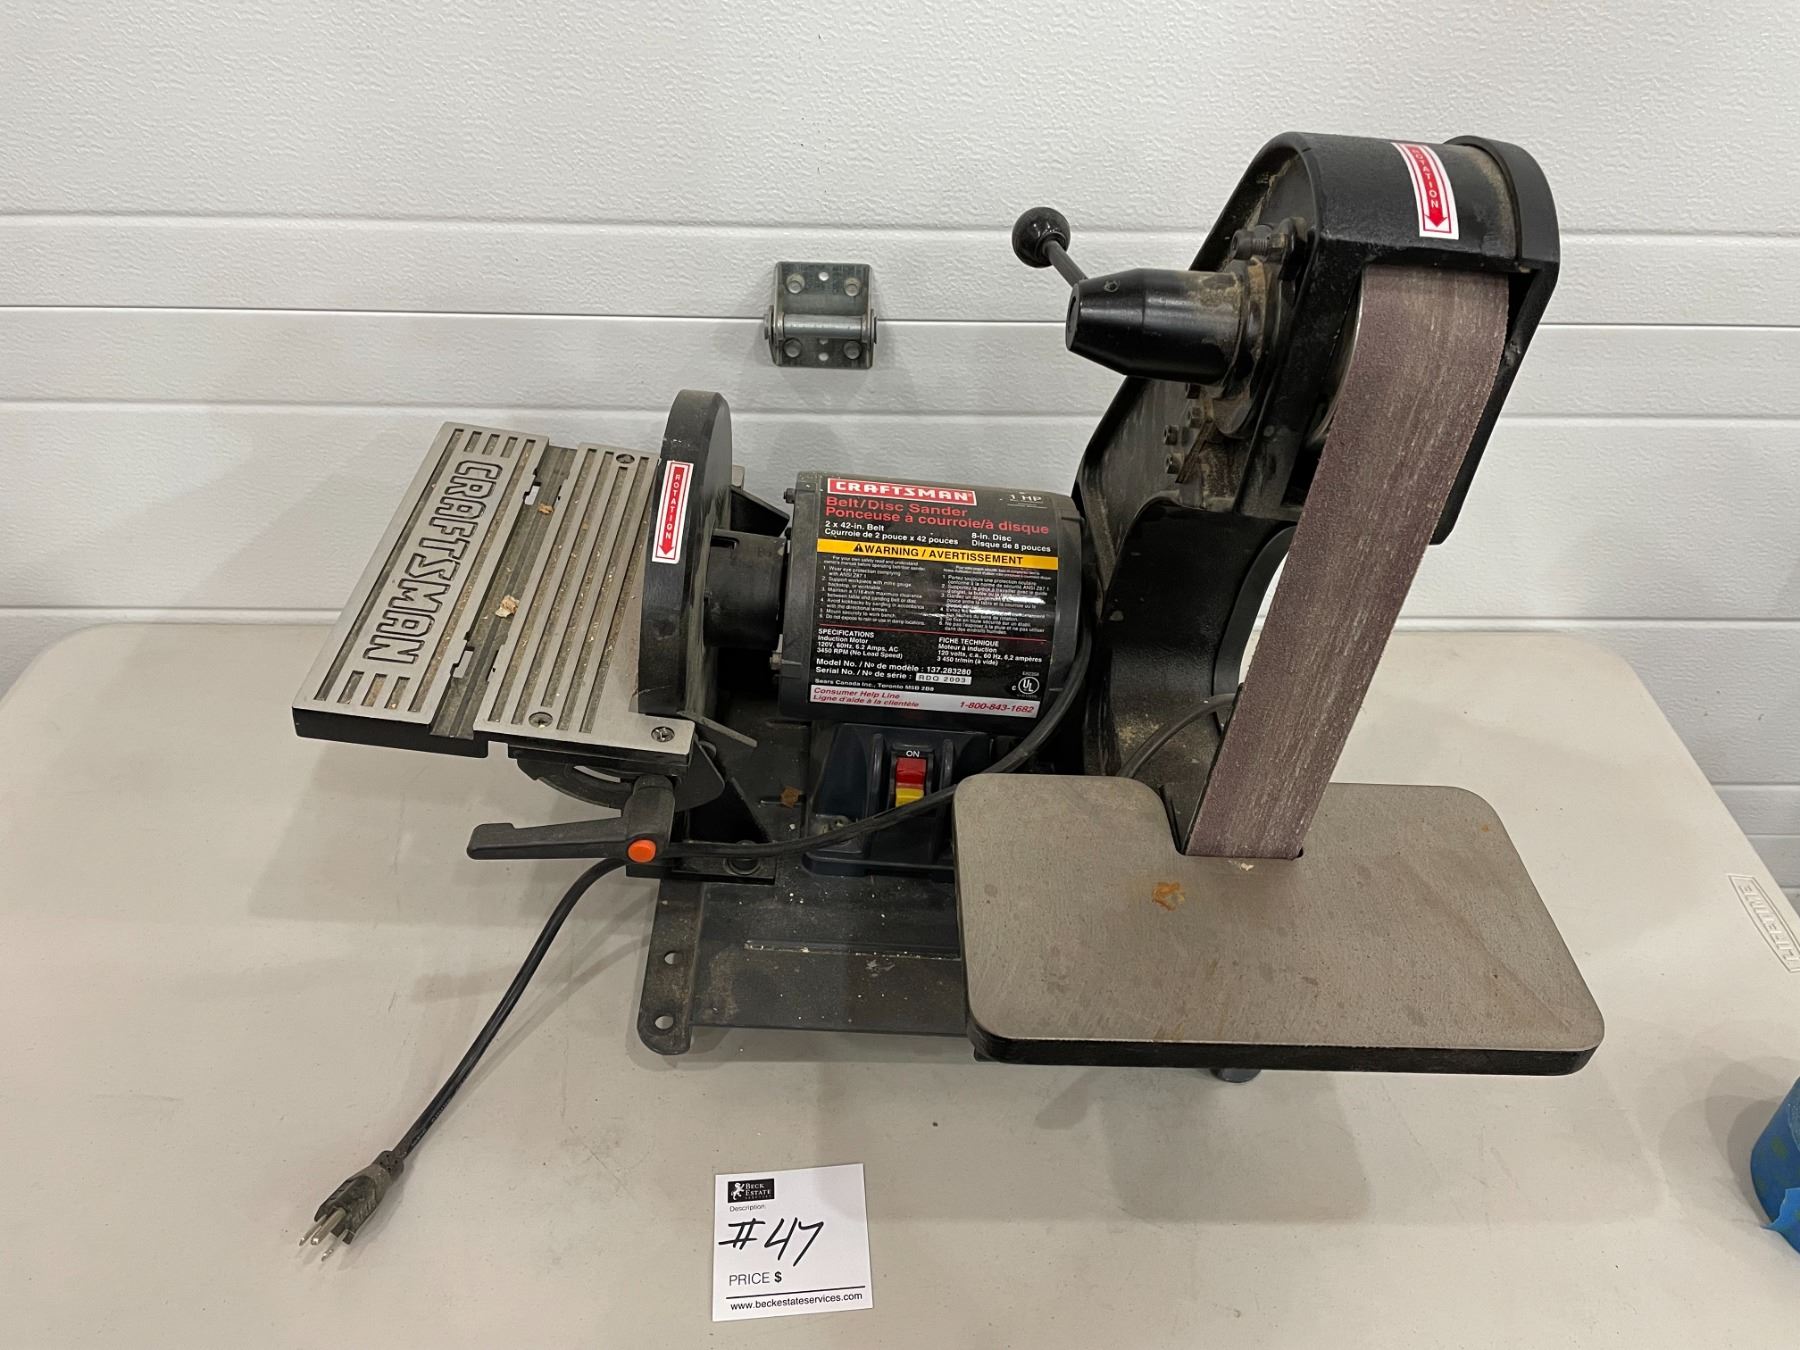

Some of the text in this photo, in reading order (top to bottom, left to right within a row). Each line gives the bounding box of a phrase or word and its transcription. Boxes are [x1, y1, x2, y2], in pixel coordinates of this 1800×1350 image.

[1411, 148, 1439, 209] ROTATION
[836, 481, 967, 500] CRAFTSMAN
[1021, 495, 1043, 503] HP
[665, 474, 681, 540] ROTATION
[826, 496, 967, 517] Belt/Disc Sander
[825, 506, 1049, 536] Ponceuse à courroie/à disque
[840, 521, 864, 529] 42-in.
[866, 523, 884, 531] Belt
[824, 527, 860, 537] Courroie
[862, 530, 872, 538] de
[882, 533, 907, 542] pouce
[928, 536, 958, 546] pouces
[992, 533, 1011, 541] Disc
[971, 539, 999, 548] Disque
[1021, 544, 1051, 553] pouces
[864, 544, 918, 556] WARNING
[921, 548, 926, 557] /
[928, 549, 1023, 565] AVERTISSEMENT
[363, 460, 503, 665] CRAFTSMAN
[817, 634, 847, 642] Induction
[818, 627, 874, 638] SPECIFICATIONS
[938, 636, 998, 647] FICHE TECHNIQUE
[880, 651, 902, 659] Speed)
[967, 645, 997, 653] induction
[982, 658, 998, 666] vide)
[1014, 654, 1042, 663] ampères
[815, 666, 839, 674] Serial
[816, 657, 840, 666] Model
[843, 659, 856, 667] No.
[888, 662, 919, 672] modèle
[926, 665, 971, 675] 137.283280
[814, 687, 857, 696] Consumer
[860, 690, 879, 698] Help
[813, 694, 836, 702] Ligne
[883, 699, 919, 707] clientèle
[960, 700, 1034, 713] 1-800-843-1682
[905, 750, 920, 758] ON
[718, 1217, 824, 1267] #47
[729, 1271, 783, 1287] PRICE $
[730, 1292, 863, 1311] www.beckestateservices.com
